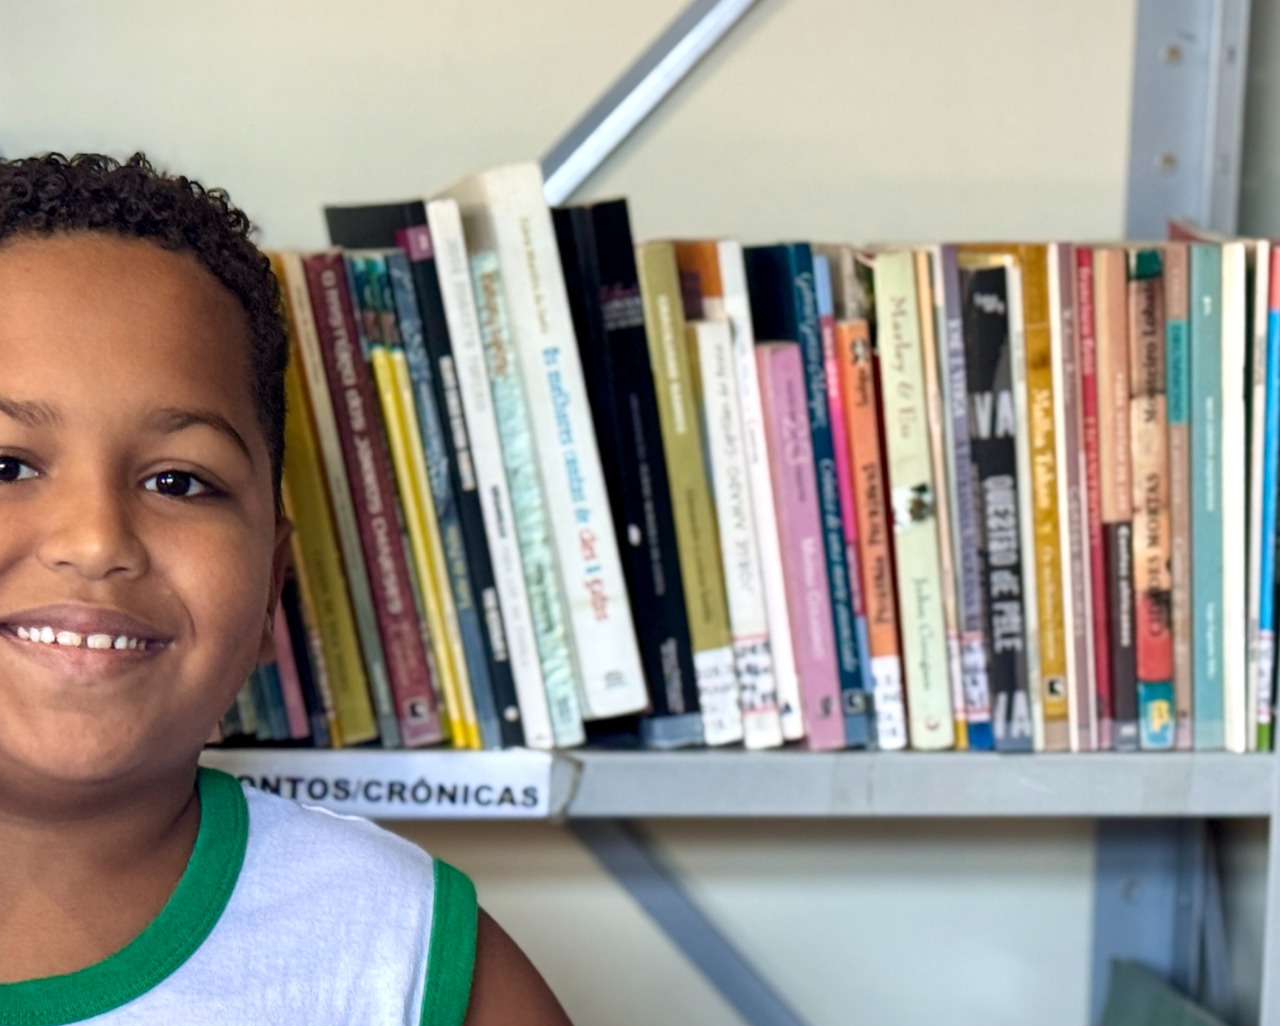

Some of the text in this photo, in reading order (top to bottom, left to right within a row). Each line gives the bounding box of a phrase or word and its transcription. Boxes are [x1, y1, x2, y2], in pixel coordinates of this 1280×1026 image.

[890, 296, 910, 374] Marley
[549, 370, 575, 445] melhores
[1032, 387, 1055, 510] Malba Tahan
[1117, 525, 1132, 584] Contos
